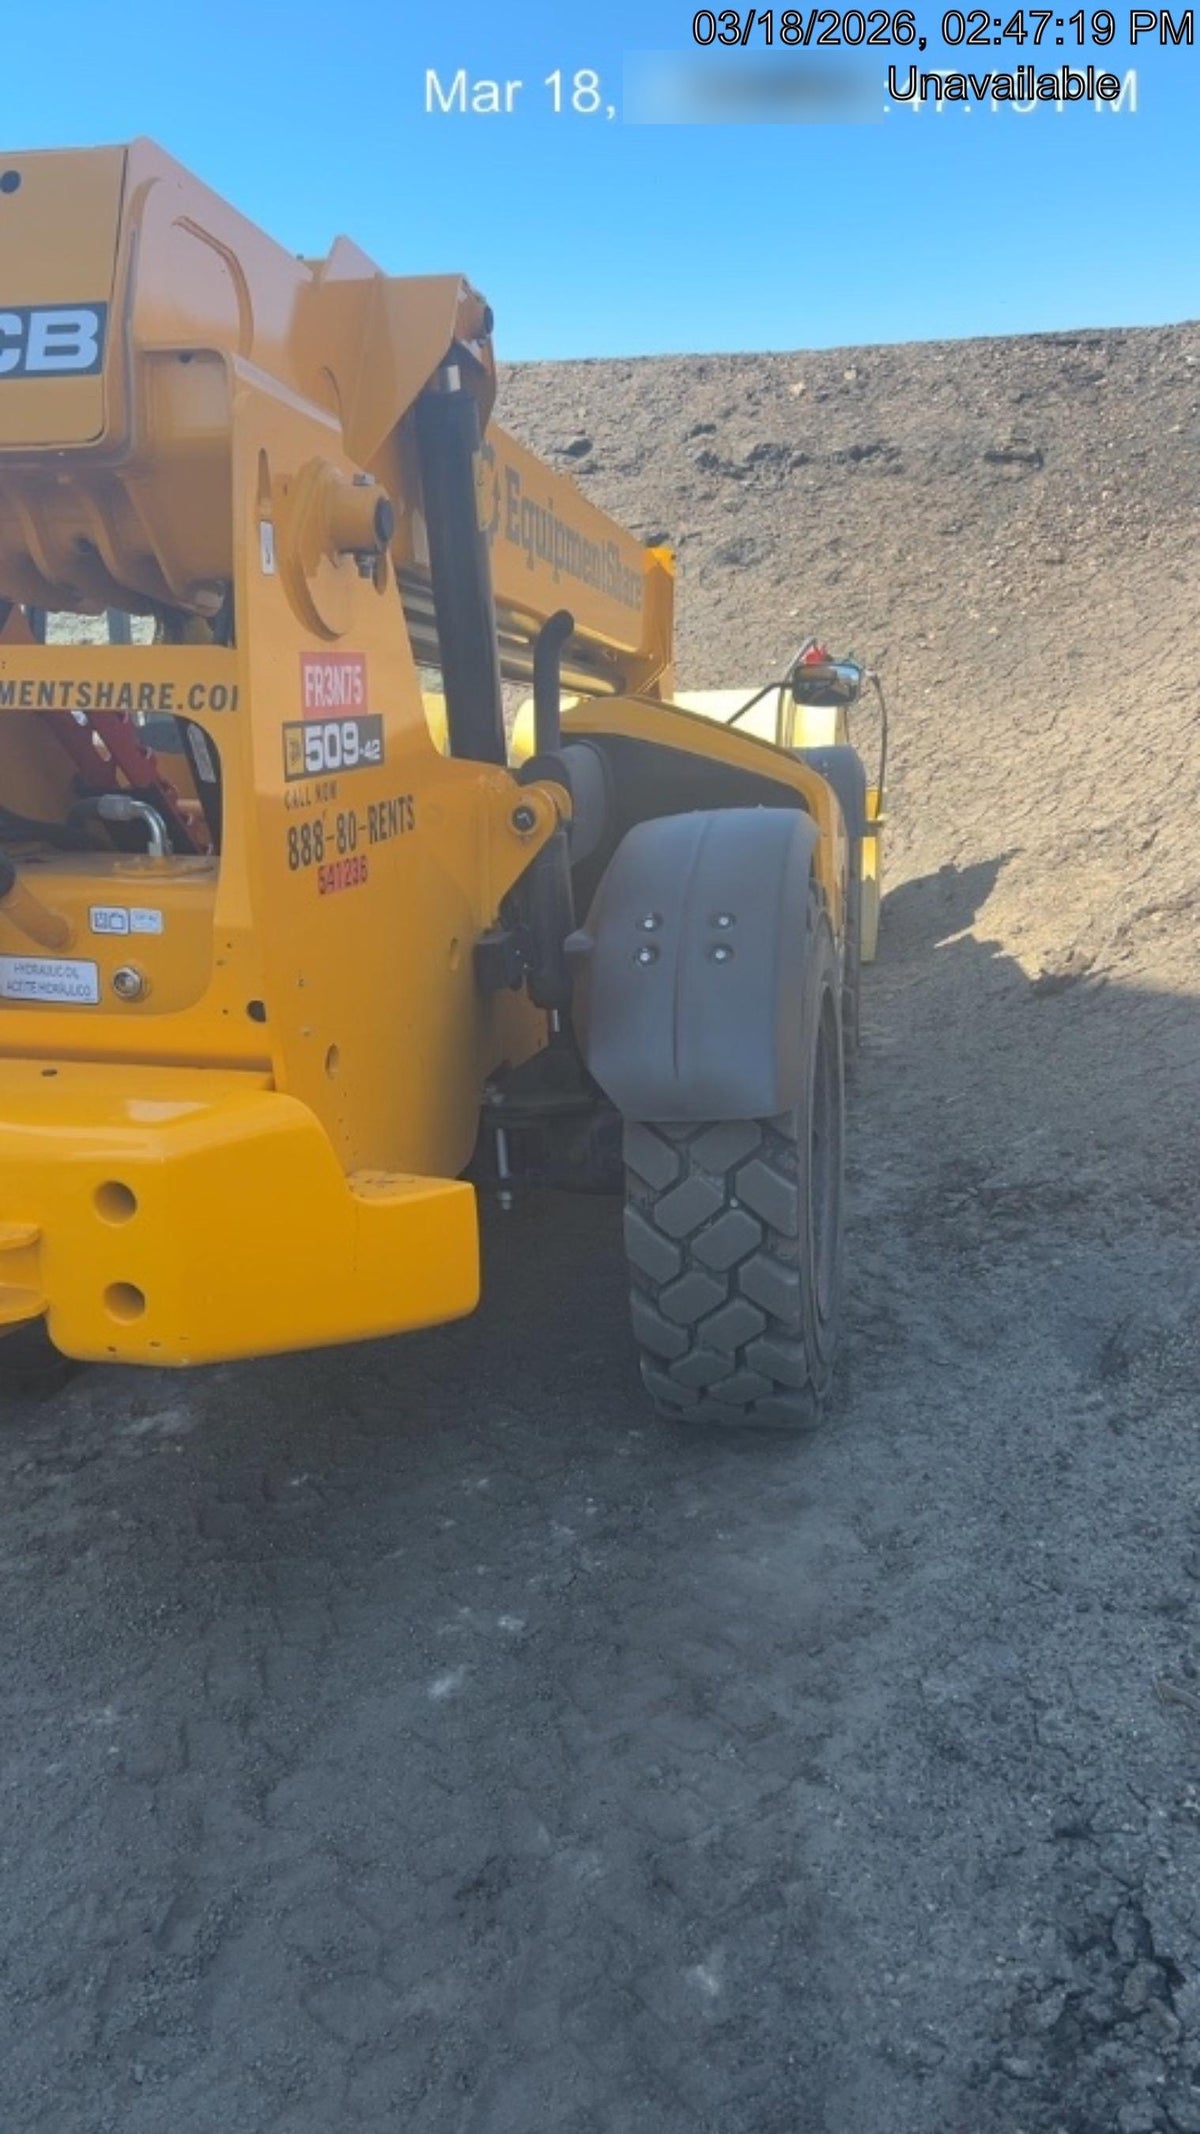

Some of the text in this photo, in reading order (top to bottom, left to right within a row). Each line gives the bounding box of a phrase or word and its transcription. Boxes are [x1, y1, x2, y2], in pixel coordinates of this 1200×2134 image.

[505, 463, 643, 611] EquipmentShare
[0, 680, 239, 711] MENTSHARE.CO
[284, 779, 338, 811] CALL NOW
[287, 794, 416, 871] 888-80-RENTS
[6, 981, 38, 993] ACEITE
